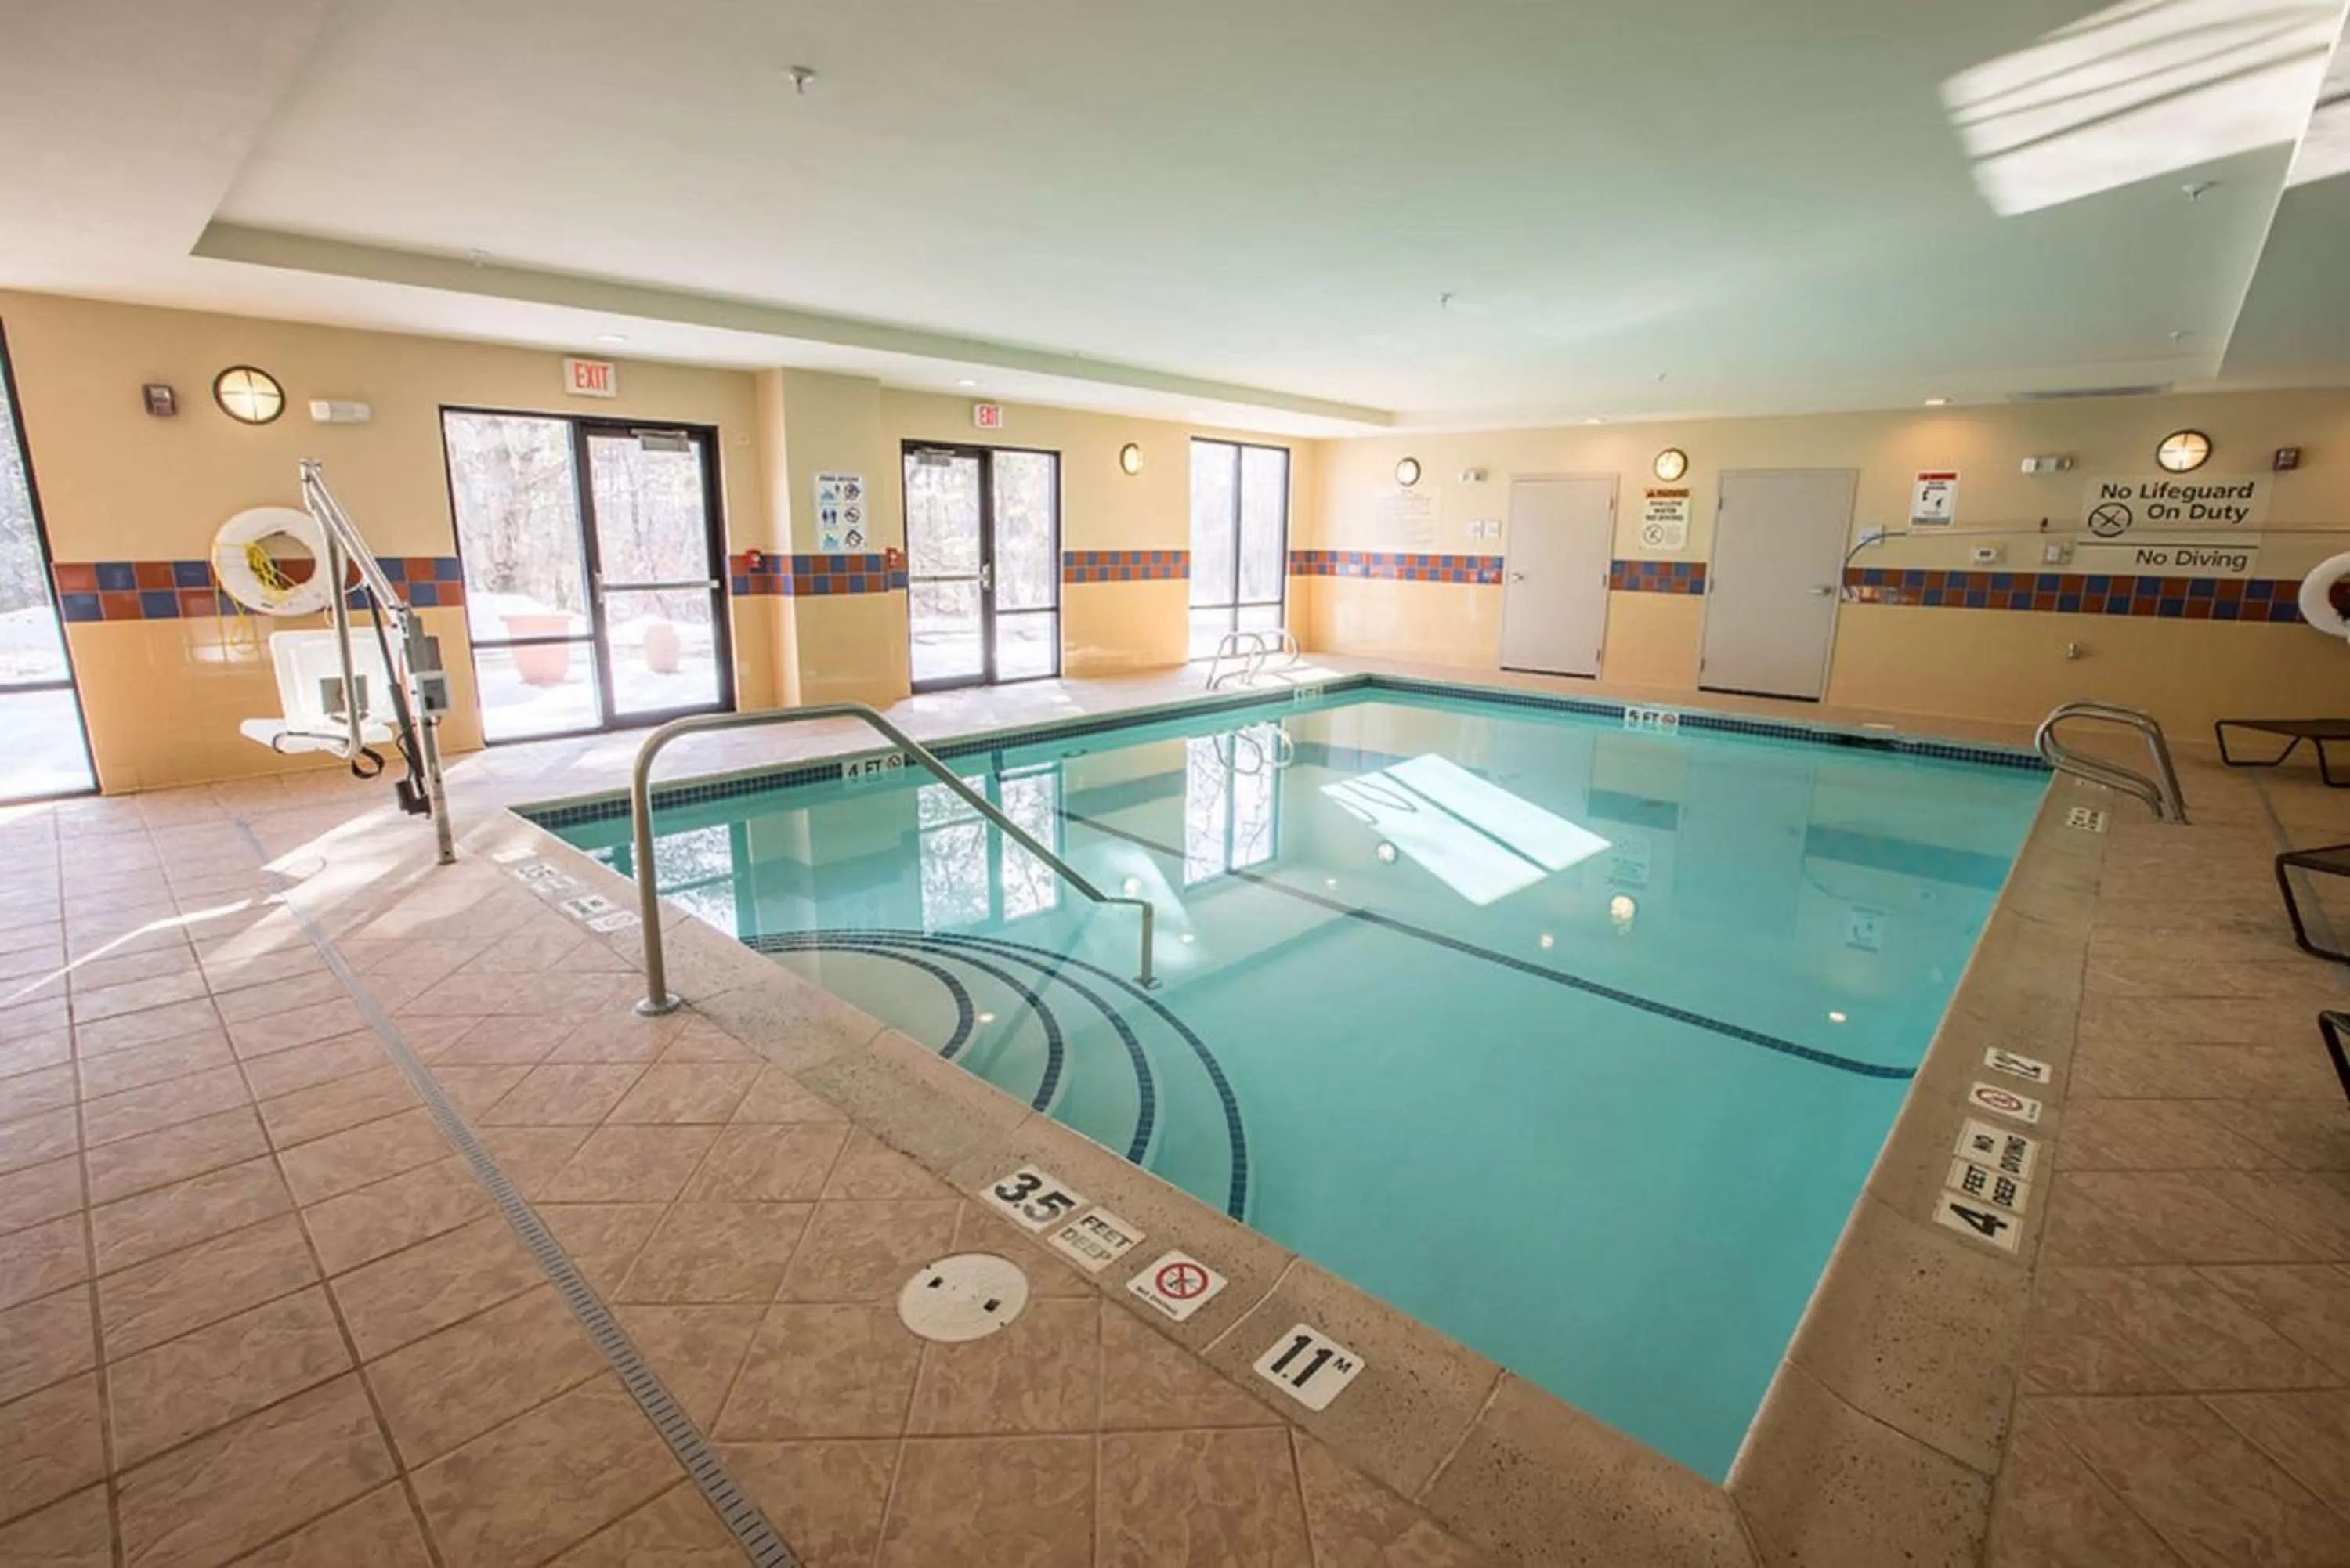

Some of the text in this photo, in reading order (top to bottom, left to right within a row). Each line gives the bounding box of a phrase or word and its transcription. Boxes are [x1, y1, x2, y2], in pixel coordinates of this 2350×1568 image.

[573, 363, 609, 390] EXIT
[2100, 482, 2254, 503] No Lifeguard
[2147, 504, 2249, 524] On Duty
[2135, 550, 2247, 572] No Diving
[865, 758, 882, 774] FT
[1972, 1134, 1995, 1154] NO
[1999, 1135, 2027, 1173] DIVING
[1961, 1164, 1987, 1196] FEET
[1992, 1176, 2017, 1207] DEEP
[994, 1172, 1076, 1223] 3.5
[1079, 1215, 1133, 1248] FEET
[1950, 1202, 2008, 1238] 4
[1059, 1227, 1112, 1260] DEEP
[1332, 1357, 1354, 1375] M
